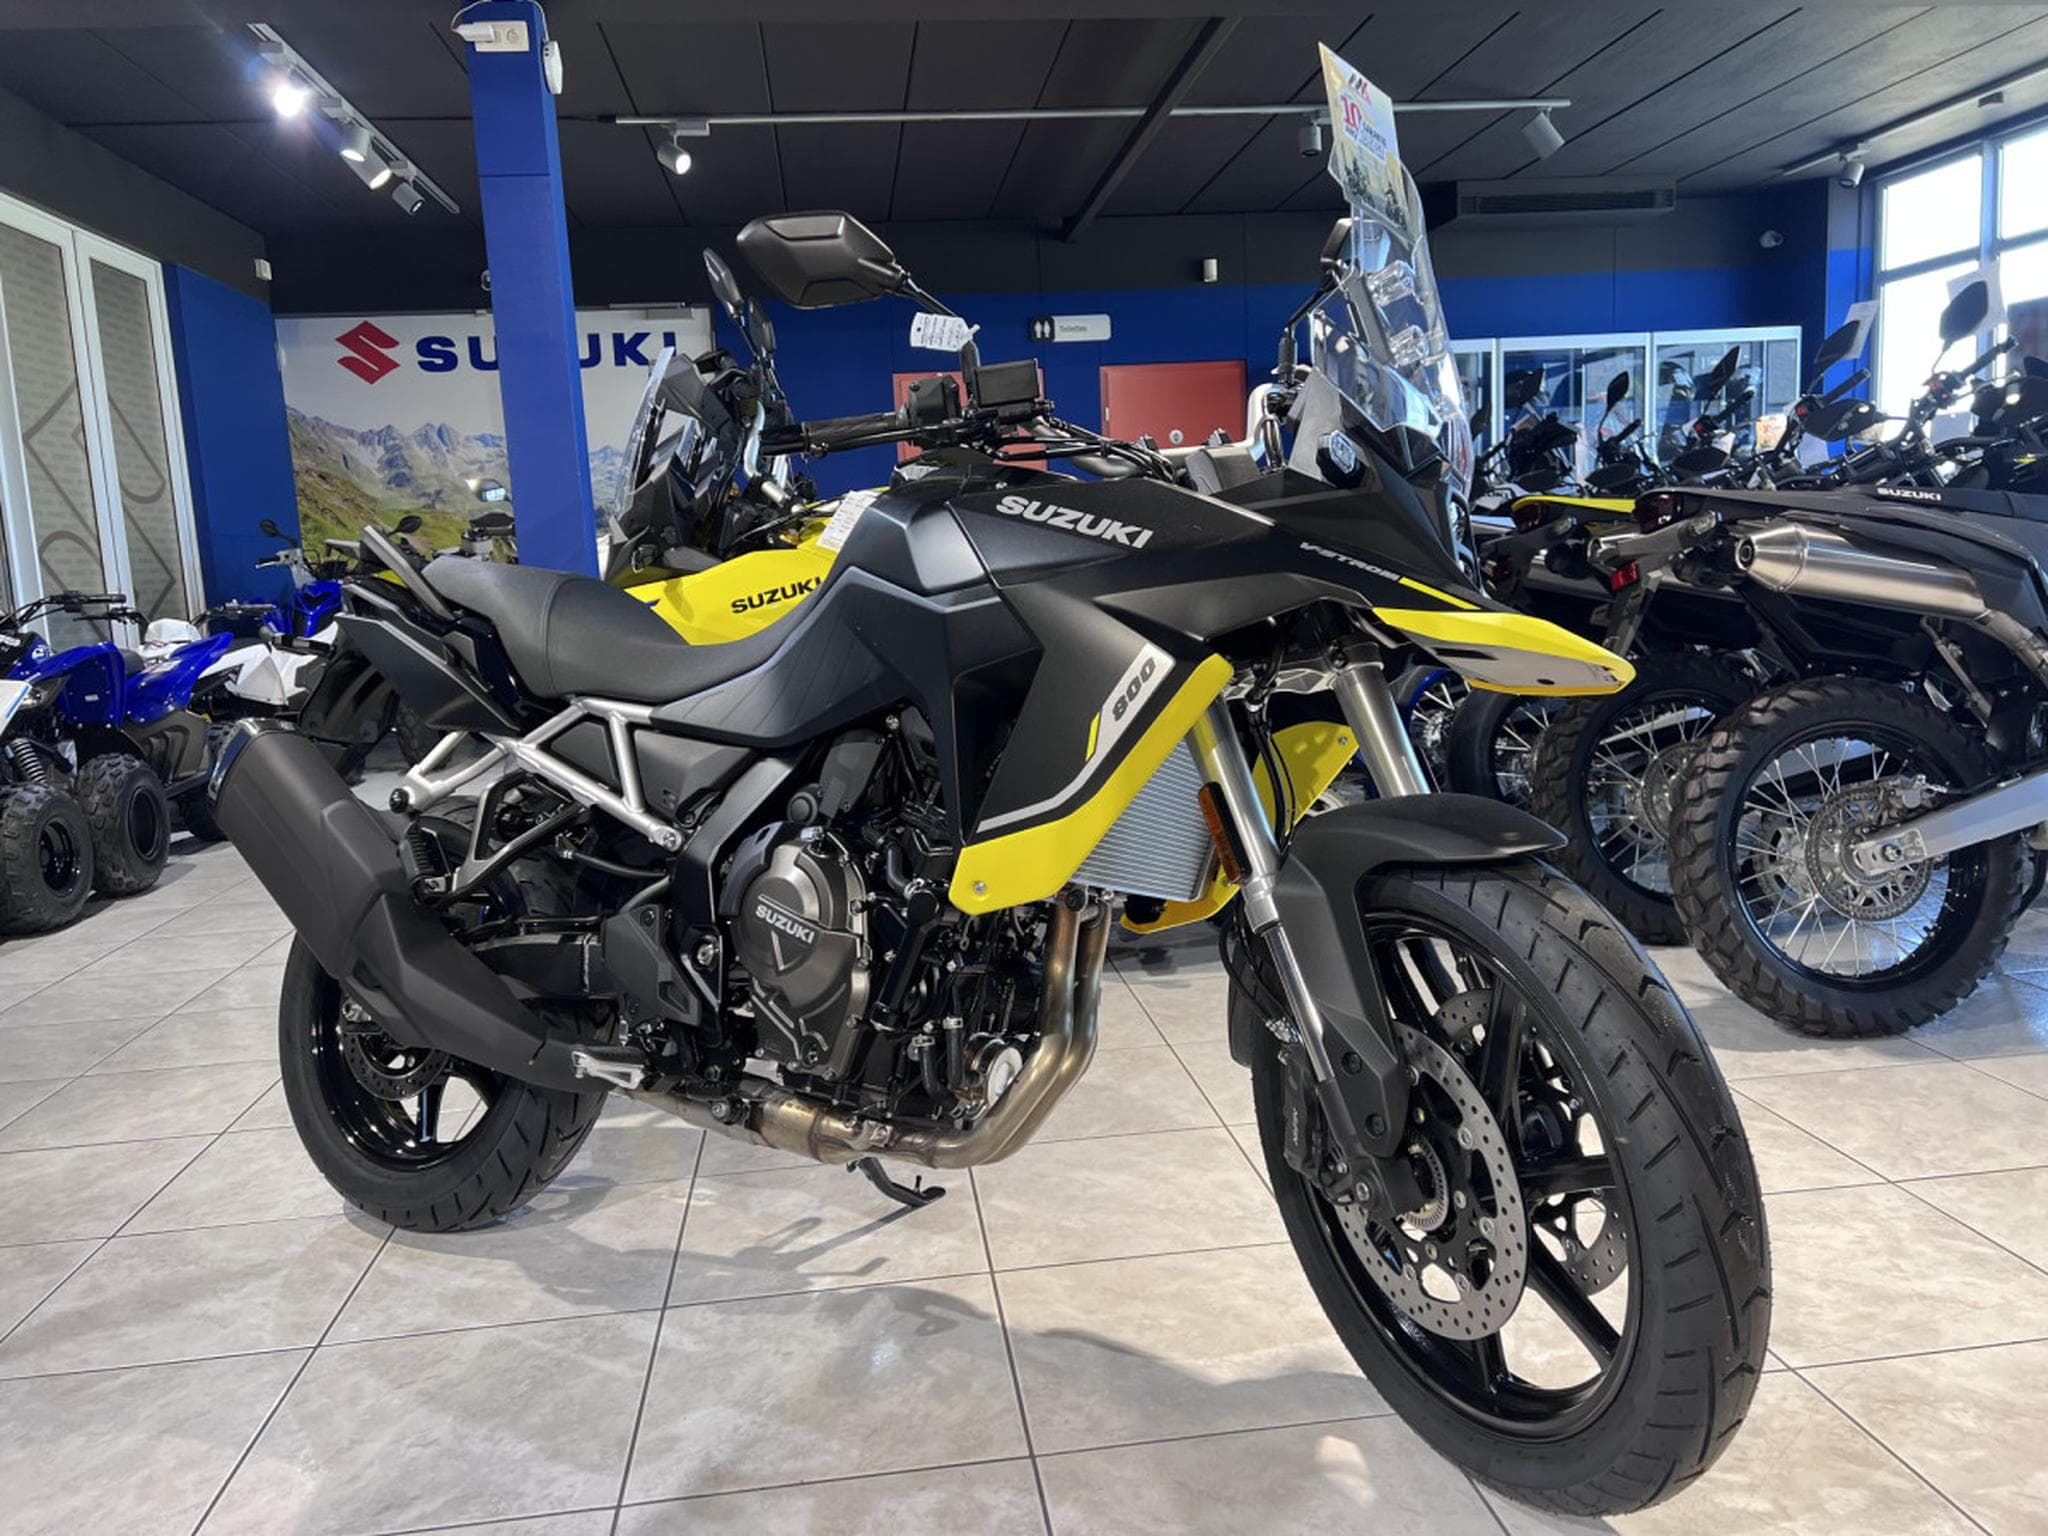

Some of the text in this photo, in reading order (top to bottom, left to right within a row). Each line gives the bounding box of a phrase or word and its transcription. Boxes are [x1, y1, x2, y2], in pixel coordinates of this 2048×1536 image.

[1877, 487, 1942, 501] SUZUKI
[996, 495, 1154, 549] SUZUKI
[1112, 657, 1156, 722] 800
[756, 904, 815, 944] SUZUKI
